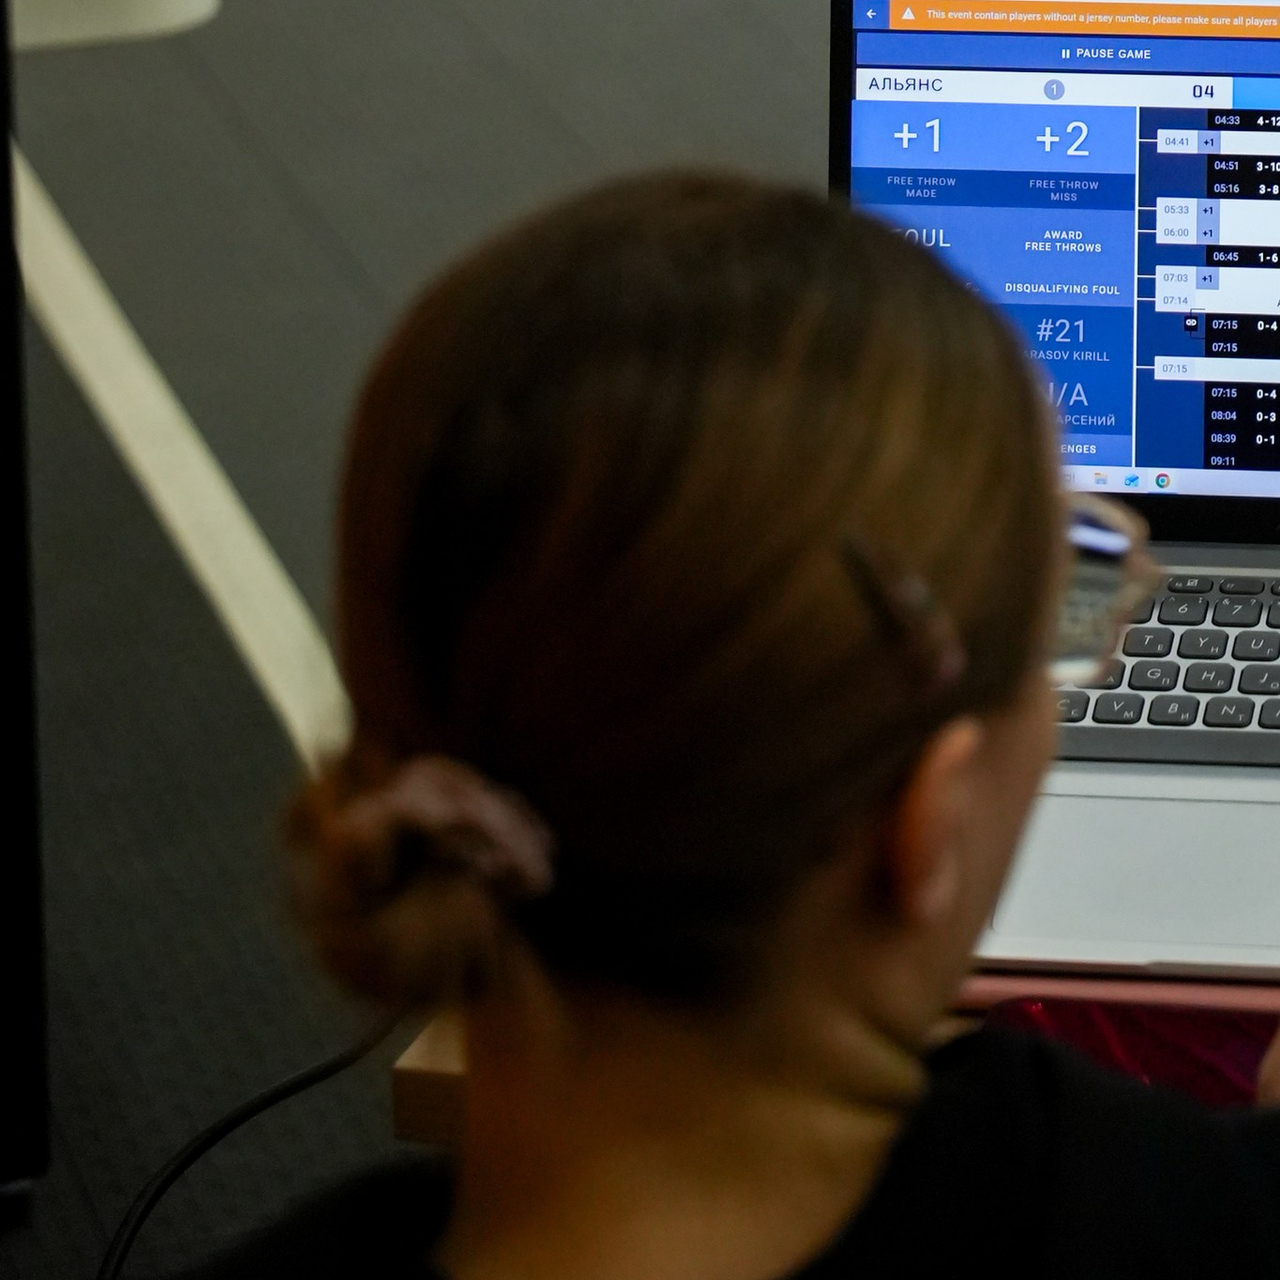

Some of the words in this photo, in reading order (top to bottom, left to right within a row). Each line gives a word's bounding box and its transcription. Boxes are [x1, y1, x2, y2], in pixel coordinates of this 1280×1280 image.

[927, 10, 945, 19] This
[975, 11, 1007, 20] contain
[1010, 12, 1041, 22] players
[1044, 12, 1076, 22] without
[1086, 14, 1112, 23] jersey
[1116, 15, 1150, 23] number,
[1153, 15, 1182, 24] please
[1185, 16, 1208, 24] make
[1233, 17, 1243, 25] all
[1246, 17, 1277, 27] players
[1077, 49, 1114, 58] PAUSE
[1118, 50, 1151, 59] GAME
[869, 78, 942, 91] АЛЬЯНС
[1051, 84, 1057, 95] 1
[1193, 84, 1214, 98] 04
[1215, 116, 1240, 125] 04:33
[894, 119, 940, 152] +1
[1036, 121, 1089, 156] +2
[1165, 137, 1189, 146] 04:41
[1204, 138, 1214, 147] +1
[1214, 161, 1238, 170] 04:51
[888, 176, 913, 185] FREE
[918, 177, 956, 186] THROW
[1030, 180, 1055, 188] FREE
[1060, 180, 1099, 189] THROW
[1214, 184, 1239, 193] 05:16
[1051, 193, 1077, 201] MISS
[1164, 206, 1189, 214] 05:33
[1203, 207, 1213, 215] +1
[1044, 231, 1082, 239] AWARD
[1164, 229, 1189, 237] 06:00
[1203, 229, 1213, 238] +1
[892, 229, 950, 247] OUL
[1025, 242, 1051, 251] FREE
[1056, 243, 1101, 252] THROWS
[1214, 252, 1238, 262] 06:45
[1163, 273, 1188, 282] 07:03
[1202, 275, 1212, 283] +1
[1005, 283, 1088, 294] DISQUALIFYING
[1093, 285, 1120, 295] FOUL
[1163, 296, 1188, 305] 07:14
[1213, 320, 1237, 329] 07:15
[1036, 319, 1084, 342] #21
[1212, 343, 1237, 352] 07:15
[1074, 351, 1110, 361] KIRILL
[1163, 364, 1187, 373] 07:15
[1212, 389, 1237, 398] 07:15
[1212, 411, 1236, 420] 08:04
[1211, 434, 1236, 443] 08:39
[1211, 456, 1235, 466] 09:11
